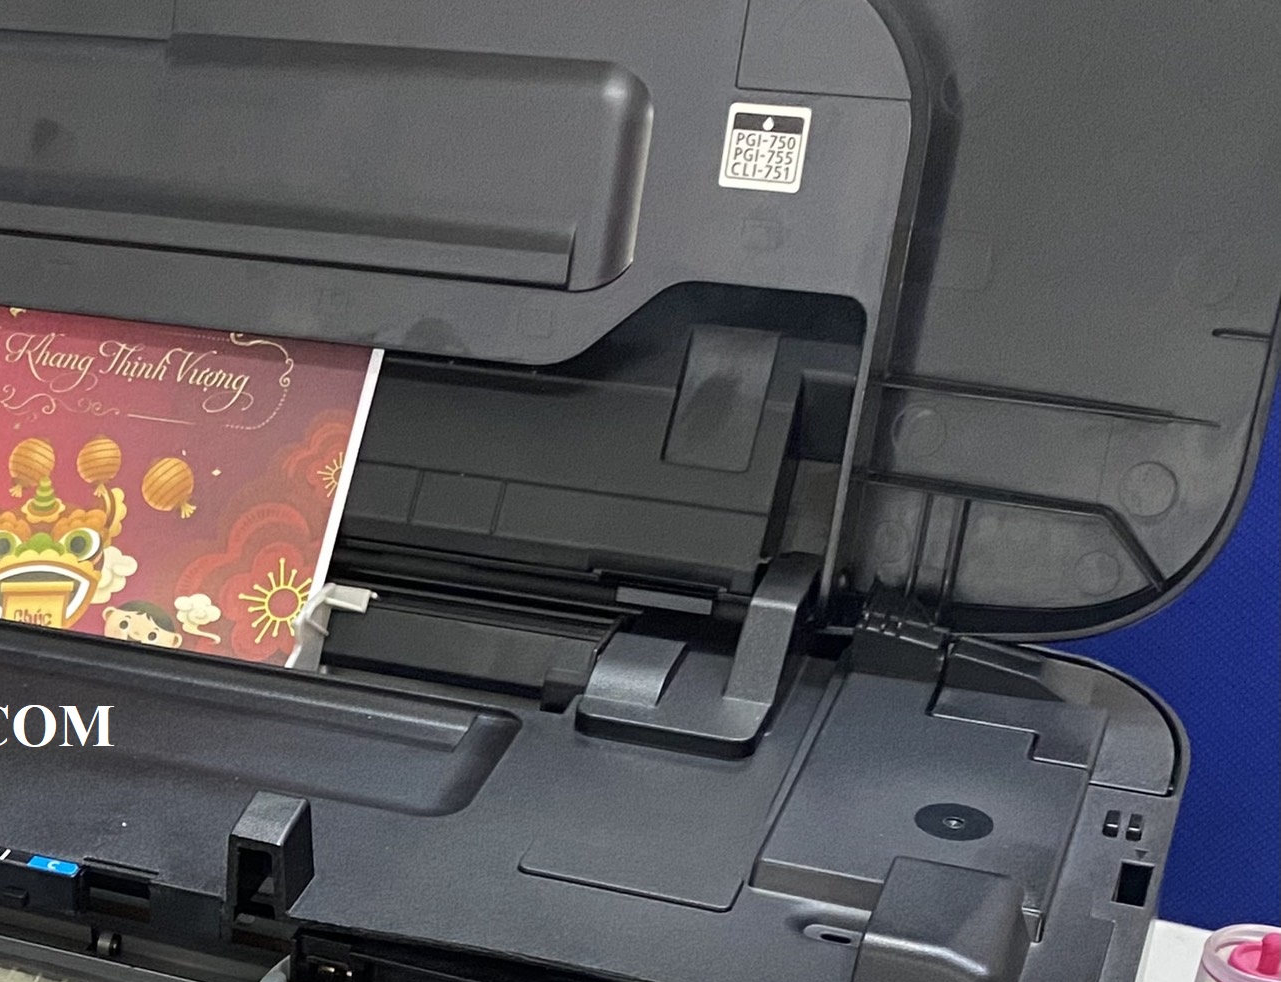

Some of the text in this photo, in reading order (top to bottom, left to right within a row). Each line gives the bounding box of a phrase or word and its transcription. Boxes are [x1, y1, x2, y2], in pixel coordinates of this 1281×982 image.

[736, 132, 796, 150] PGI-750
[733, 147, 794, 165] PGI-755
[731, 162, 790, 180] CLI-751
[5, 332, 99, 393] Khang
[99, 340, 169, 383] Thịnh
[167, 348, 254, 413] Vượng
[47, 861, 60, 870] C
